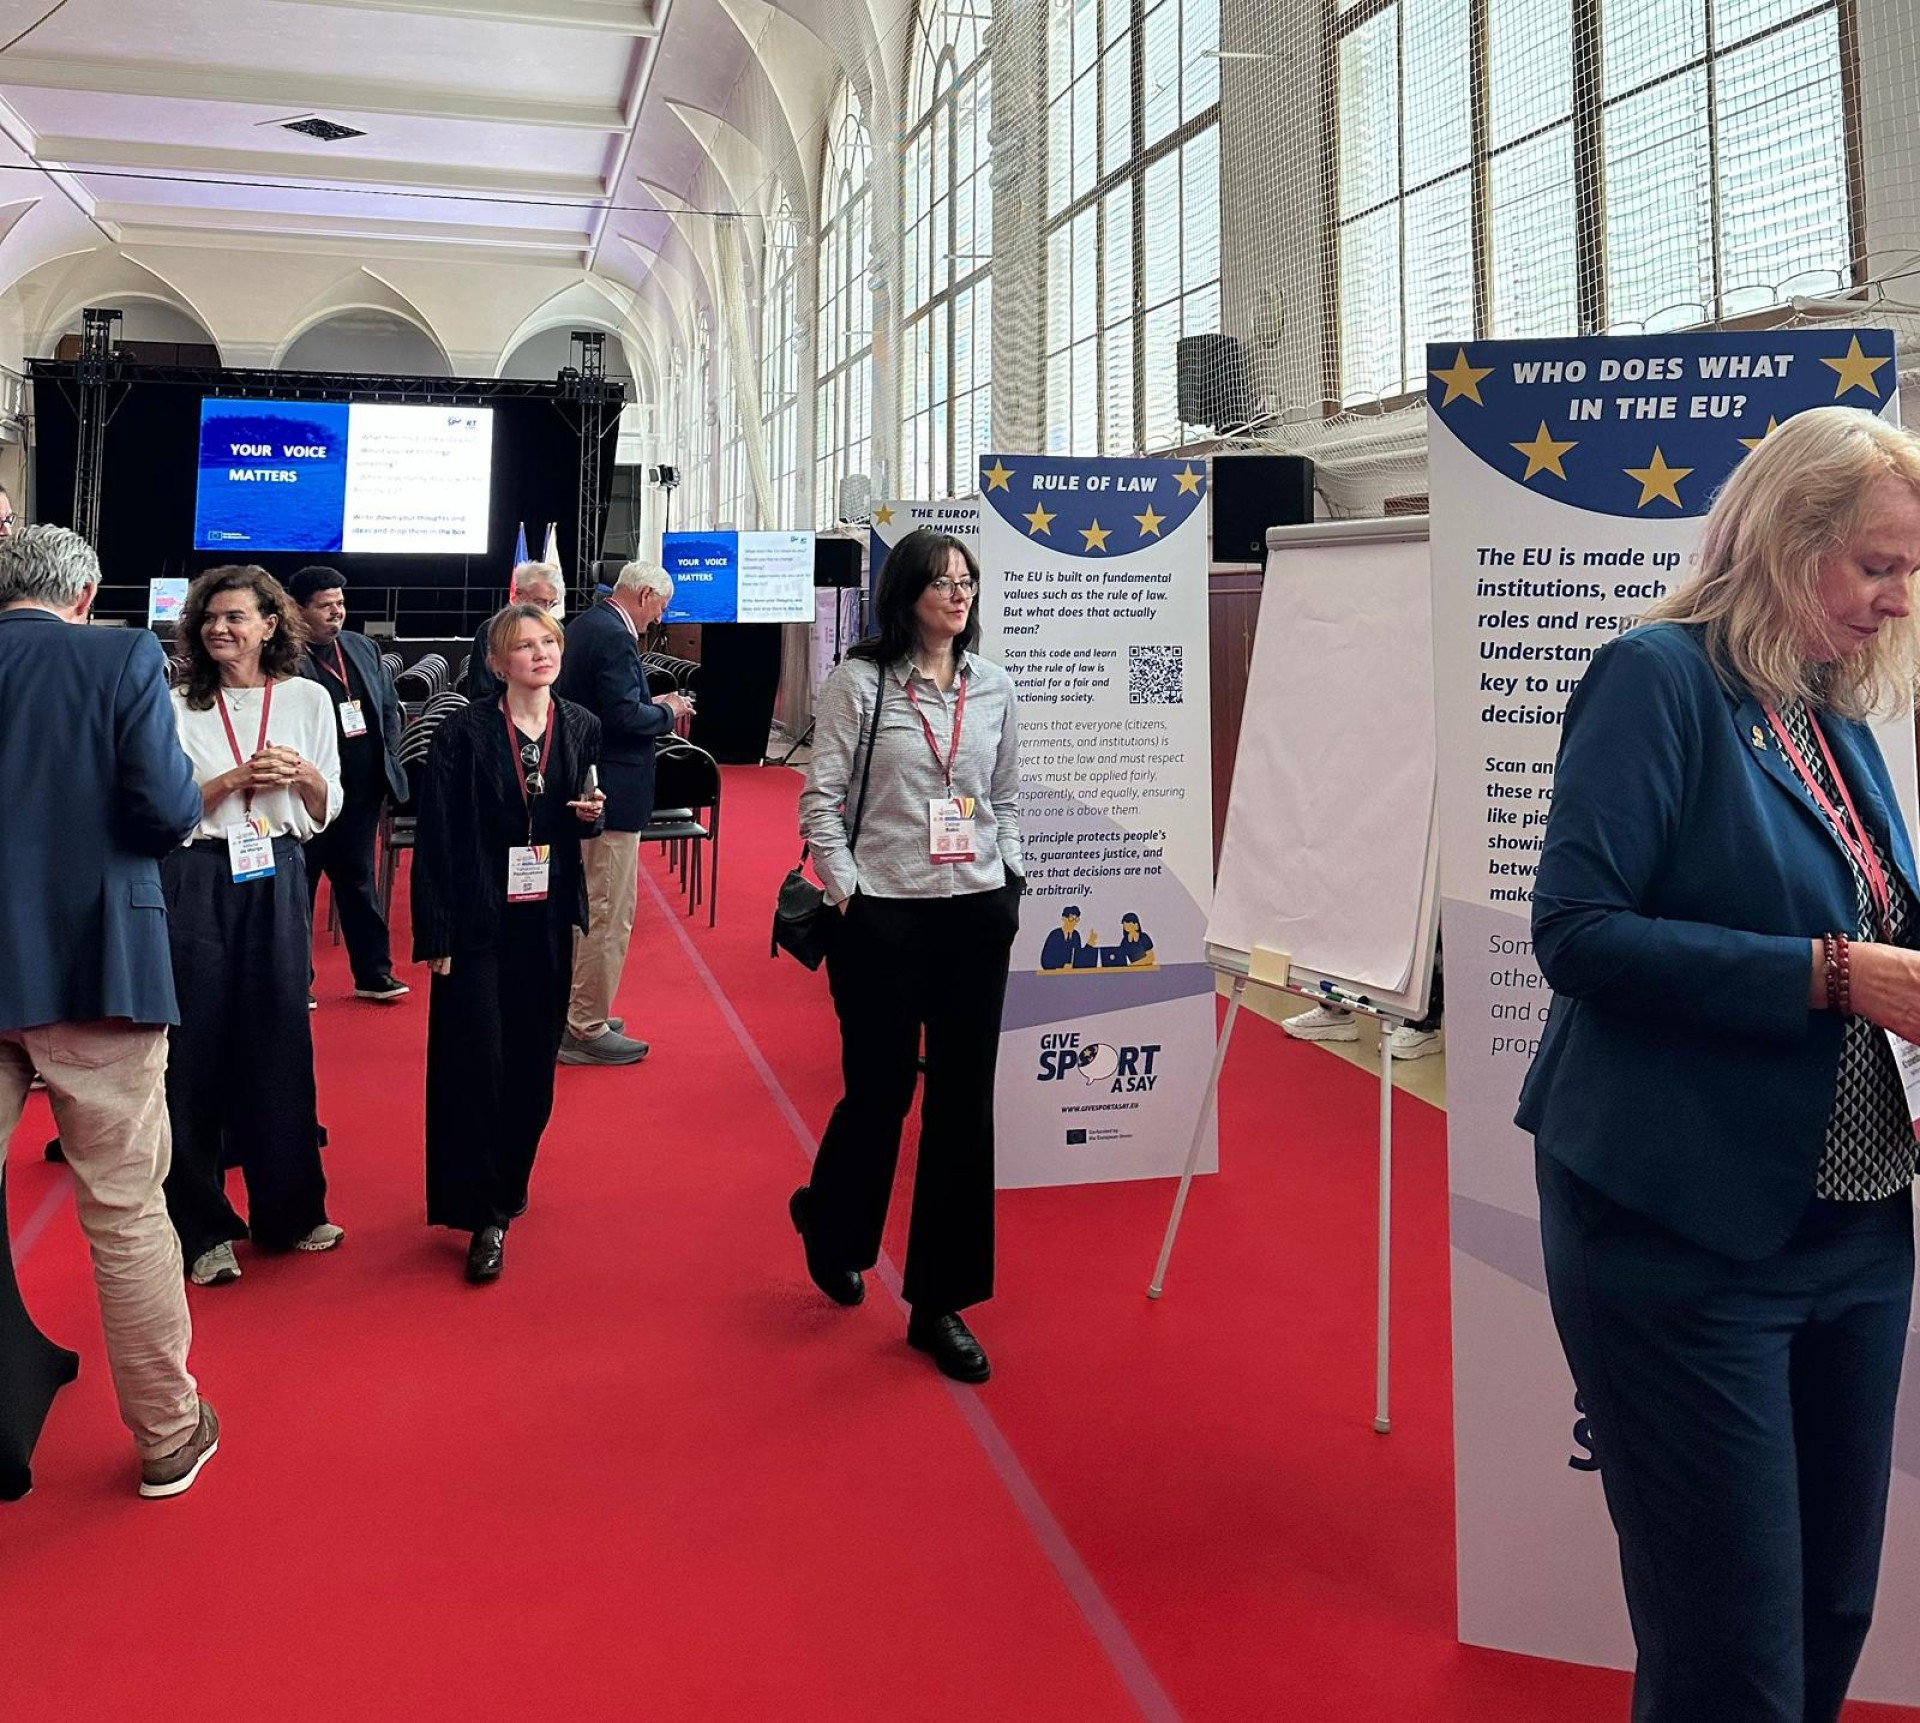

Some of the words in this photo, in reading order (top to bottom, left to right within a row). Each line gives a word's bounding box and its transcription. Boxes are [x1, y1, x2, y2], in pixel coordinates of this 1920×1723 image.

[1513, 361, 1586, 383] WHO
[1600, 358, 1683, 381] DOES
[1699, 355, 1793, 378] WHAT
[1570, 399, 1602, 420] IN
[1616, 397, 1677, 419] THE
[1690, 396, 1746, 418] EU?
[231, 444, 271, 456] YOUR
[283, 446, 326, 458] VOICE
[229, 469, 297, 482] MATTERS
[1033, 475, 1079, 490] RULE
[1087, 476, 1110, 490] OF
[1117, 477, 1157, 492] LAW
[911, 509, 933, 518] THE
[918, 524, 979, 535] COMMISSI
[1477, 548, 1515, 565] The
[1523, 548, 1552, 565] EU
[1560, 547, 1575, 565] is
[1584, 548, 1644, 565] made
[1653, 553, 1680, 571] up
[678, 573, 713, 581] MATTERS
[1004, 571, 1024, 581] The
[1028, 572, 1042, 582] EU
[1046, 571, 1054, 582] is
[1058, 571, 1082, 582] built
[1103, 572, 1171, 584] fundamental
[1004, 589, 1038, 599] values
[1043, 589, 1067, 599] such
[1087, 590, 1104, 599] the
[1107, 590, 1128, 600] rule
[1131, 590, 1143, 602] of
[1146, 590, 1167, 600] law.
[1477, 578, 1605, 601] institutions,
[1614, 580, 1666, 598] each
[1004, 607, 1023, 616] But
[1027, 607, 1054, 617] what
[1058, 607, 1083, 617] does
[1087, 607, 1109, 617] that
[1113, 607, 1156, 620] actually
[1478, 610, 1529, 628] roles
[1537, 612, 1578, 629] and
[1003, 624, 1039, 634] mean?
[1005, 649, 1026, 657] Scan
[1030, 649, 1046, 657] this
[1050, 649, 1071, 657] code
[1074, 649, 1091, 657] and
[1094, 649, 1116, 657] learn
[1005, 663, 1024, 674] why
[1027, 664, 1042, 672] the
[1045, 664, 1063, 672] rule
[1066, 663, 1076, 673] of
[1079, 663, 1095, 672] law
[1098, 664, 1104, 672] is
[1015, 678, 1045, 687] sential
[1048, 678, 1061, 689] for
[1073, 678, 1089, 688] fair
[1092, 678, 1109, 686] and
[1480, 672, 1518, 696] key
[1526, 676, 1549, 692] to
[1061, 693, 1094, 703] society.
[1051, 720, 1072, 730] that
[1075, 722, 1122, 732] everyone
[1125, 720, 1166, 730] (citizens,
[1077, 737, 1097, 747] and
[1099, 736, 1158, 746] institutions)
[1161, 736, 1169, 745] is
[1044, 756, 1054, 764] to
[1057, 754, 1074, 764] the
[1077, 754, 1094, 764] law
[1098, 753, 1117, 763] and
[1120, 754, 1145, 763] must
[1148, 754, 1184, 765] respect
[1485, 757, 1525, 773] Scan
[1019, 773, 1042, 781] aws
[1045, 773, 1071, 781] must
[1074, 771, 1087, 781] be
[1090, 770, 1127, 783] applied
[1130, 770, 1157, 782] fairly,
[1079, 788, 1098, 798] and
[1101, 787, 1139, 800] equally,
[1142, 788, 1185, 799] ensuring
[1487, 783, 1532, 799] these
[1044, 808, 1063, 816] one
[1067, 808, 1074, 816] is
[1077, 805, 1109, 816] above
[1112, 805, 1141, 815] them.
[1487, 808, 1517, 823] like
[1028, 832, 1074, 845] principle
[1077, 832, 1120, 844] protects
[1123, 830, 1166, 843] people's
[1041, 850, 1100, 863] guarantees
[1102, 848, 1139, 861] justice,
[1143, 847, 1163, 857] and
[1048, 868, 1070, 877] that
[1074, 866, 1120, 876] decisions
[1124, 867, 1141, 875] are
[1145, 866, 1161, 875] not
[1037, 884, 1092, 897] arbitrarily.
[1490, 968, 1551, 989] other
[1491, 1002, 1530, 1020] and
[1041, 1033, 1080, 1049] GIVE
[1111, 1079, 1122, 1093] A
[1127, 1076, 1157, 1092] SAY
